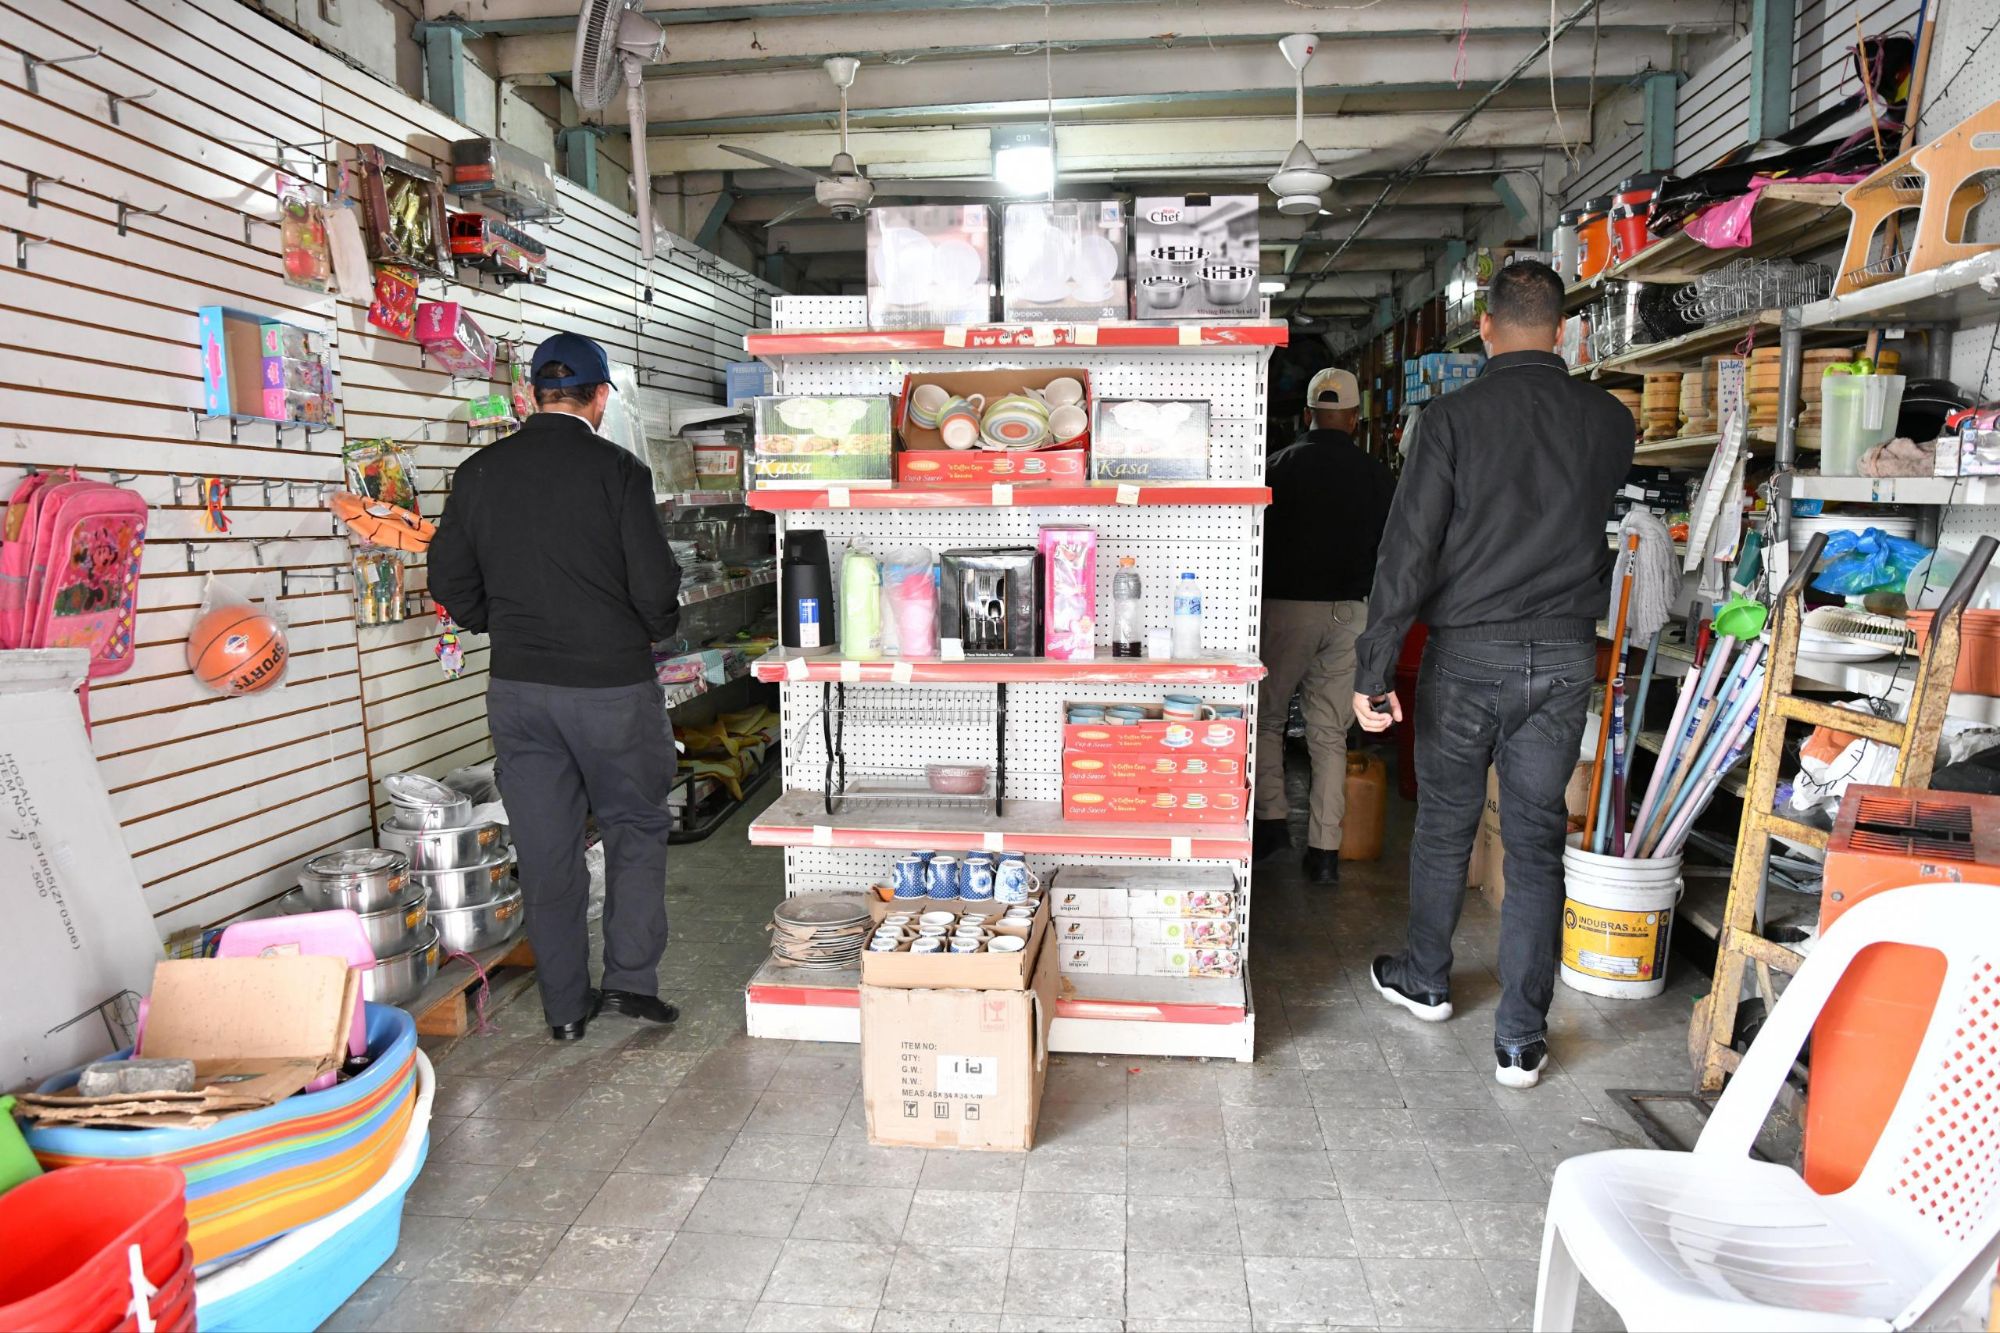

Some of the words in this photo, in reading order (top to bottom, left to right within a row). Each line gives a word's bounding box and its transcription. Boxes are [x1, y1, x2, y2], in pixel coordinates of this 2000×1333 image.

[1150, 211, 1181, 223] Chef
[1102, 307, 1114, 317] 20
[756, 459, 813, 478] Kasa
[1099, 459, 1150, 478] Kasa
[234, 642, 285, 690] SPORTS
[5, 753, 42, 827] HOGALUX
[1579, 915, 1629, 932] INDUBRAS
[901, 1042, 920, 1050] ITEM
[922, 1043, 937, 1051] NO:
